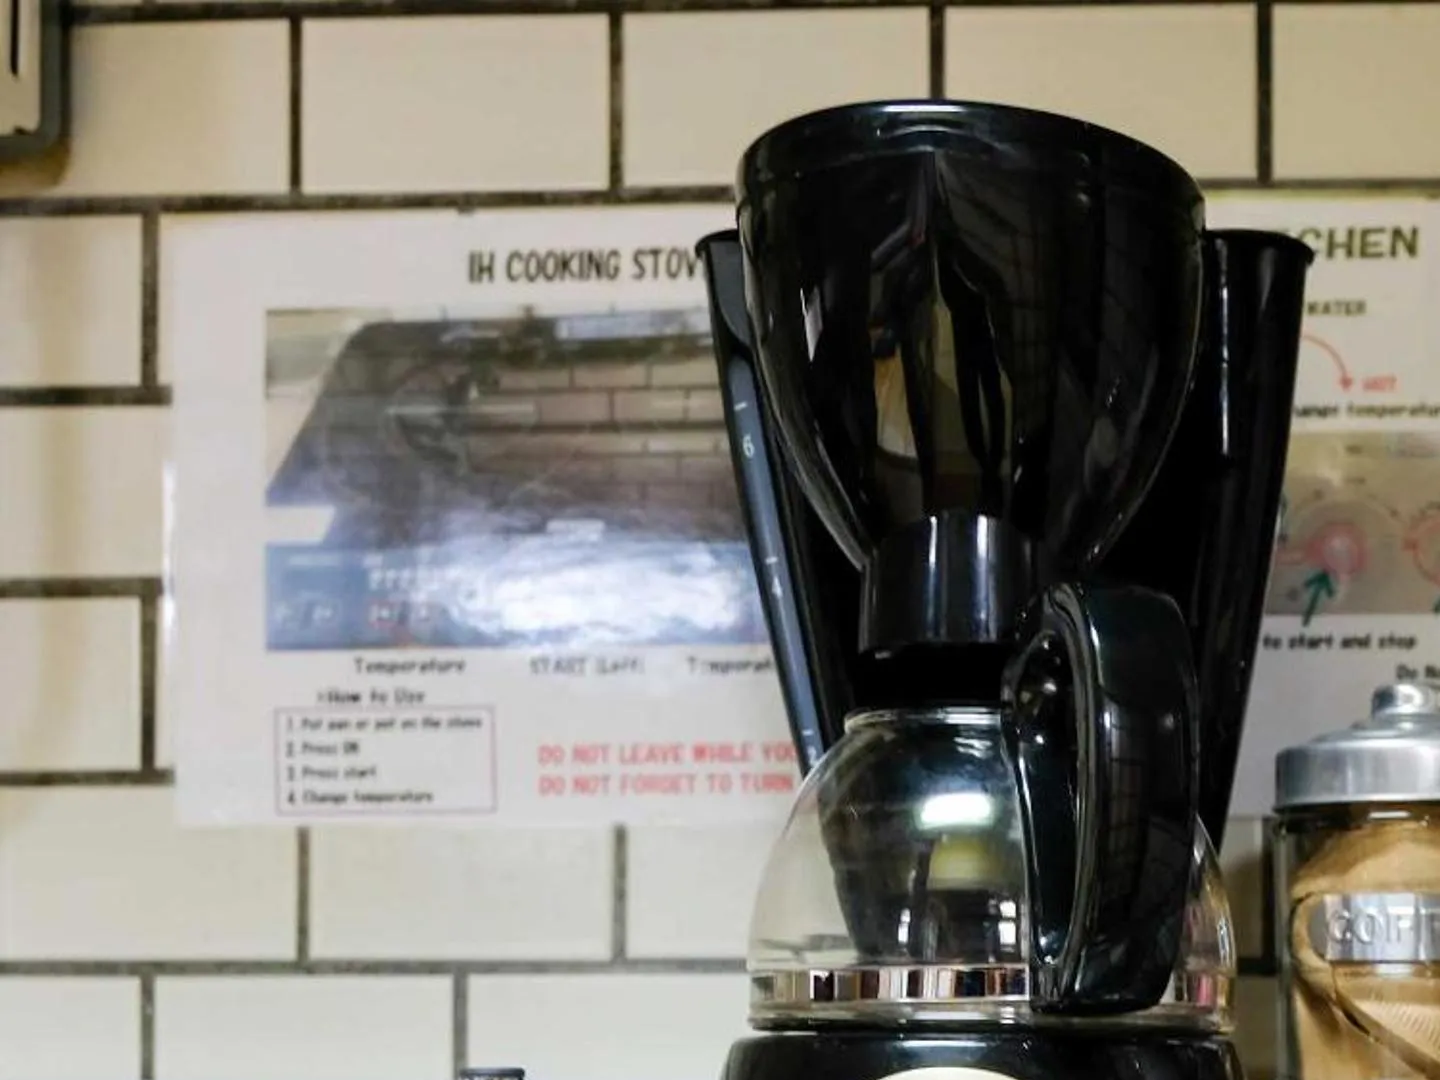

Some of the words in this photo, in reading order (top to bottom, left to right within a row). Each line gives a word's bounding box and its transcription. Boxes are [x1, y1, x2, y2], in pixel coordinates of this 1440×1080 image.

[505, 248, 621, 283] COOKING
[632, 246, 698, 280] STOV
[741, 433, 756, 459] 6
[353, 656, 466, 675] Temperature
[536, 744, 566, 766] DO
[571, 743, 611, 765] NOT
[618, 742, 686, 765] LEAVE
[536, 775, 567, 796] DO
[571, 774, 611, 796] NOT
[618, 774, 698, 795] FORGET
